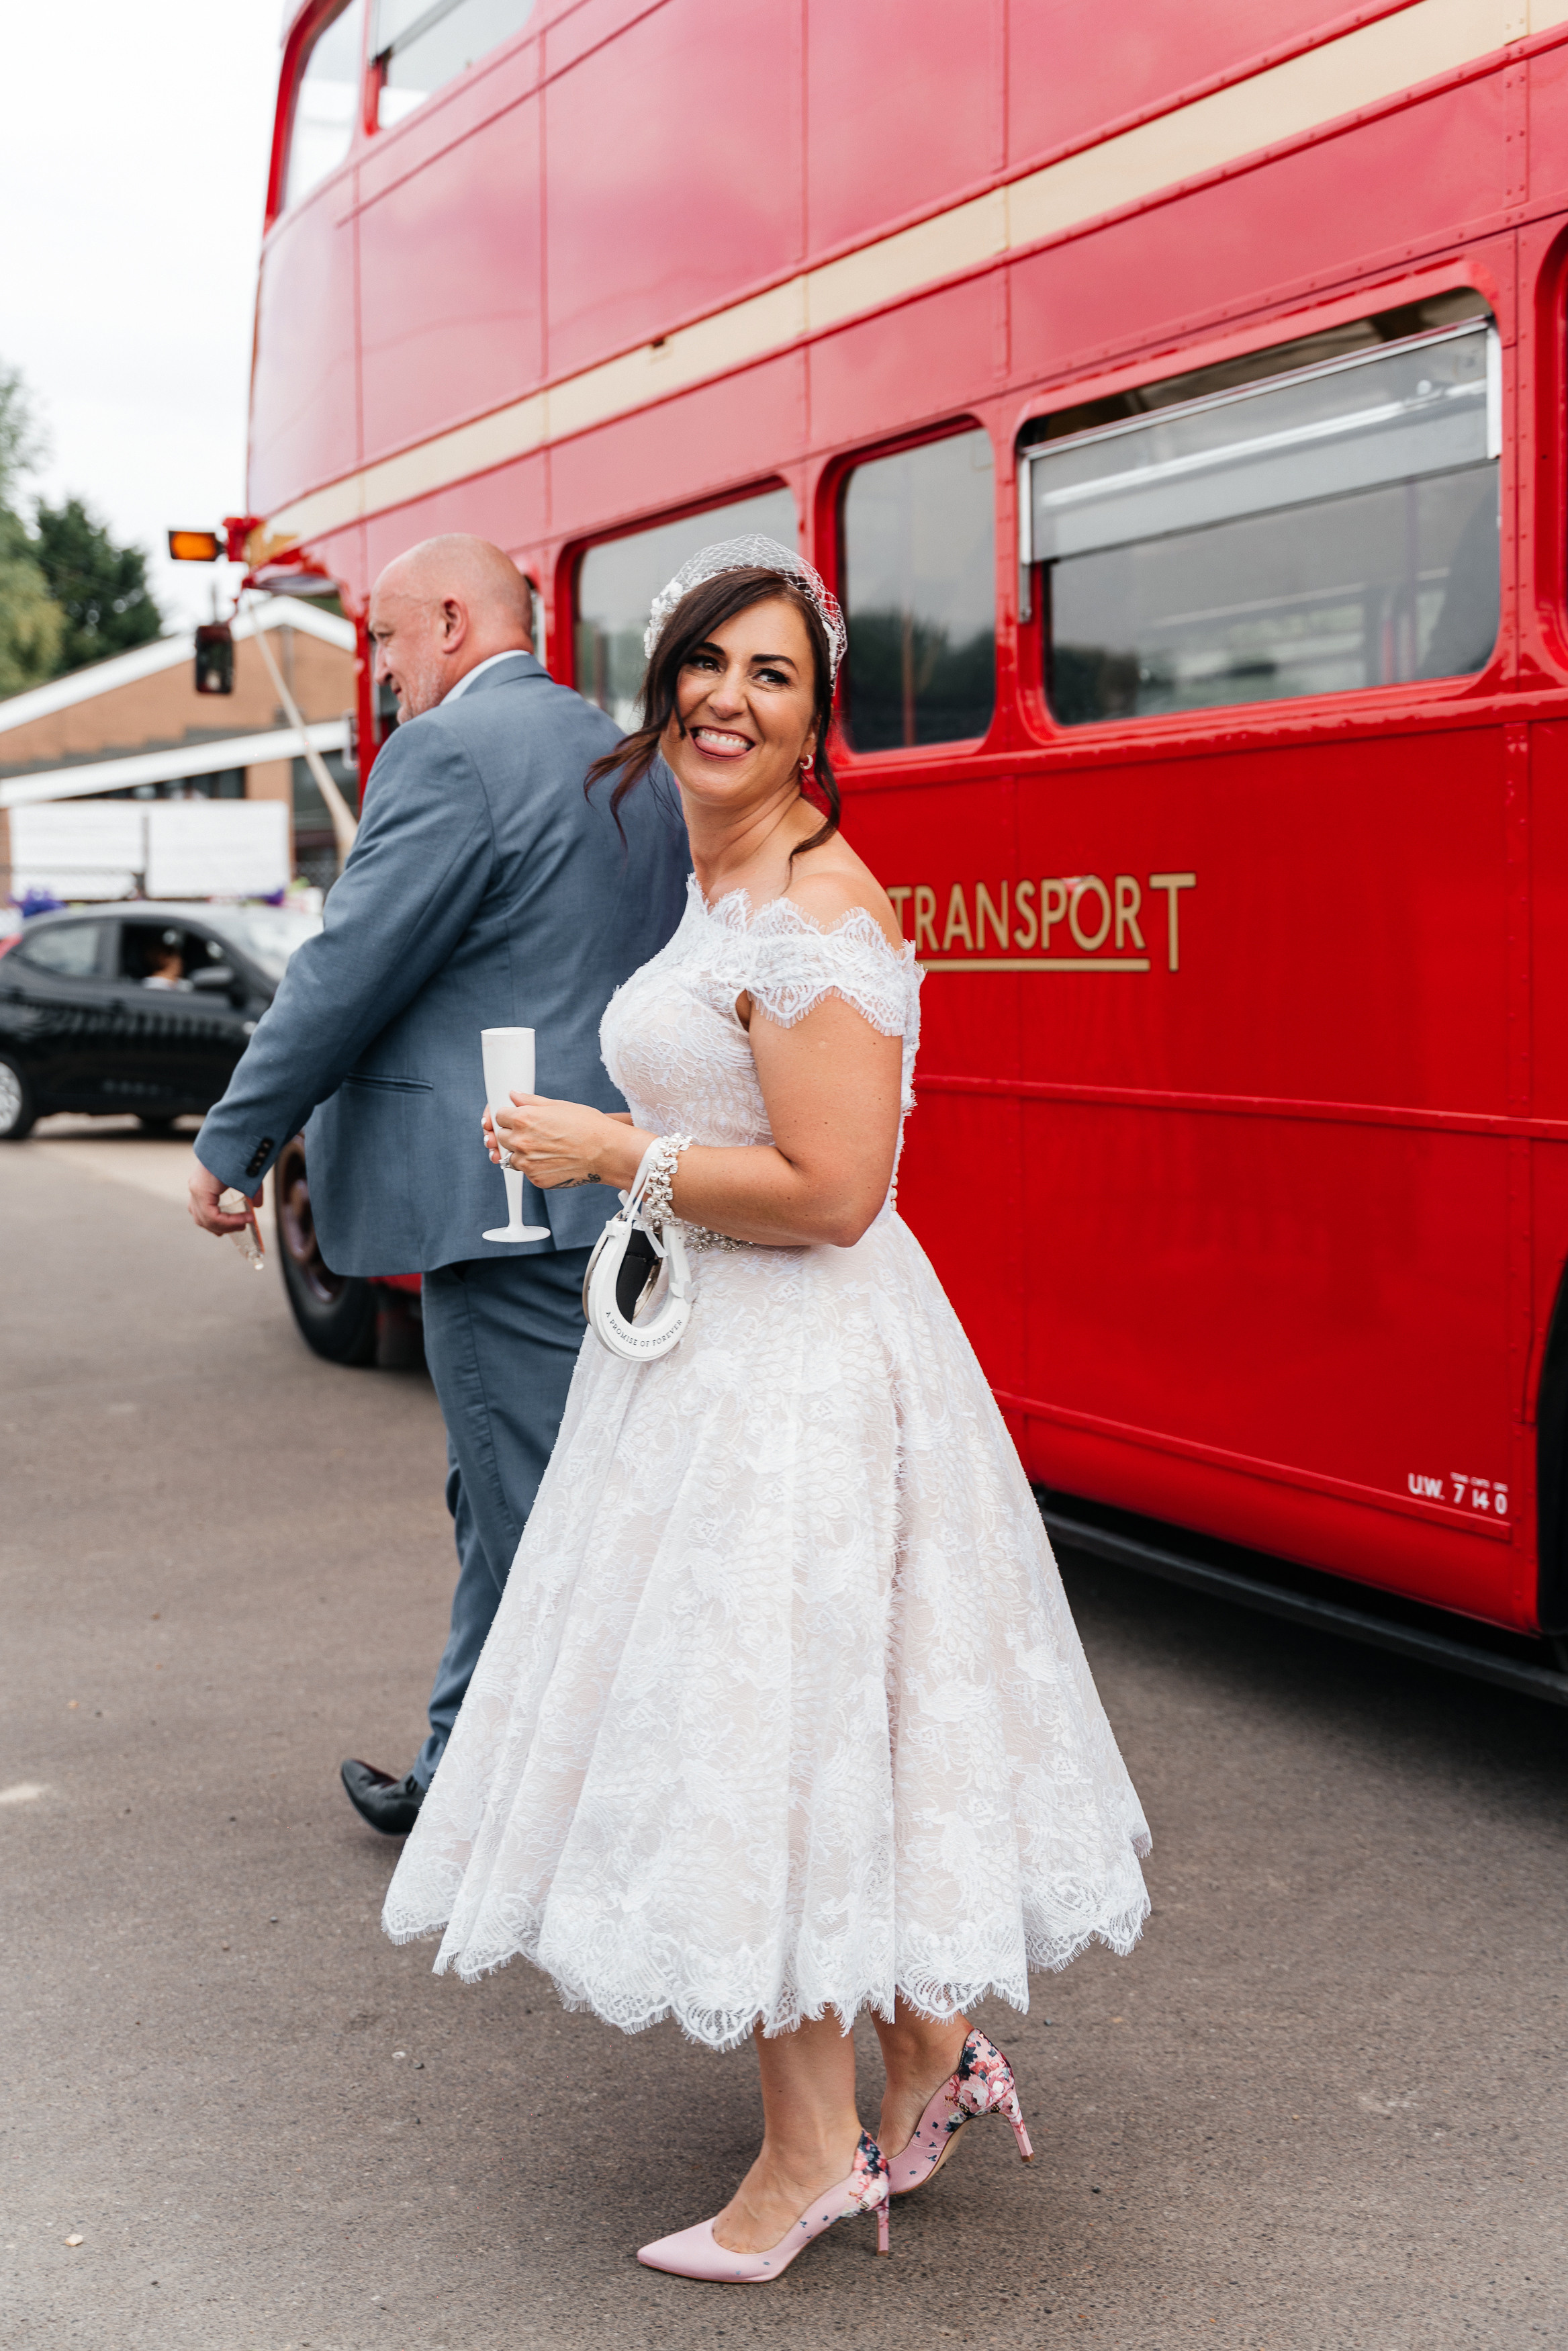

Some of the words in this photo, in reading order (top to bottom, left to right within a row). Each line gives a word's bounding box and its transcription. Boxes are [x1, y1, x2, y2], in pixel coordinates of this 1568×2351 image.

[886, 872, 1197, 973] TRANSPORT
[610, 1319, 637, 1345] PROMISE
[653, 1319, 682, 1346] FOREVER
[1453, 1482, 1465, 1504] 7
[1494, 1493, 1508, 1515] 0
